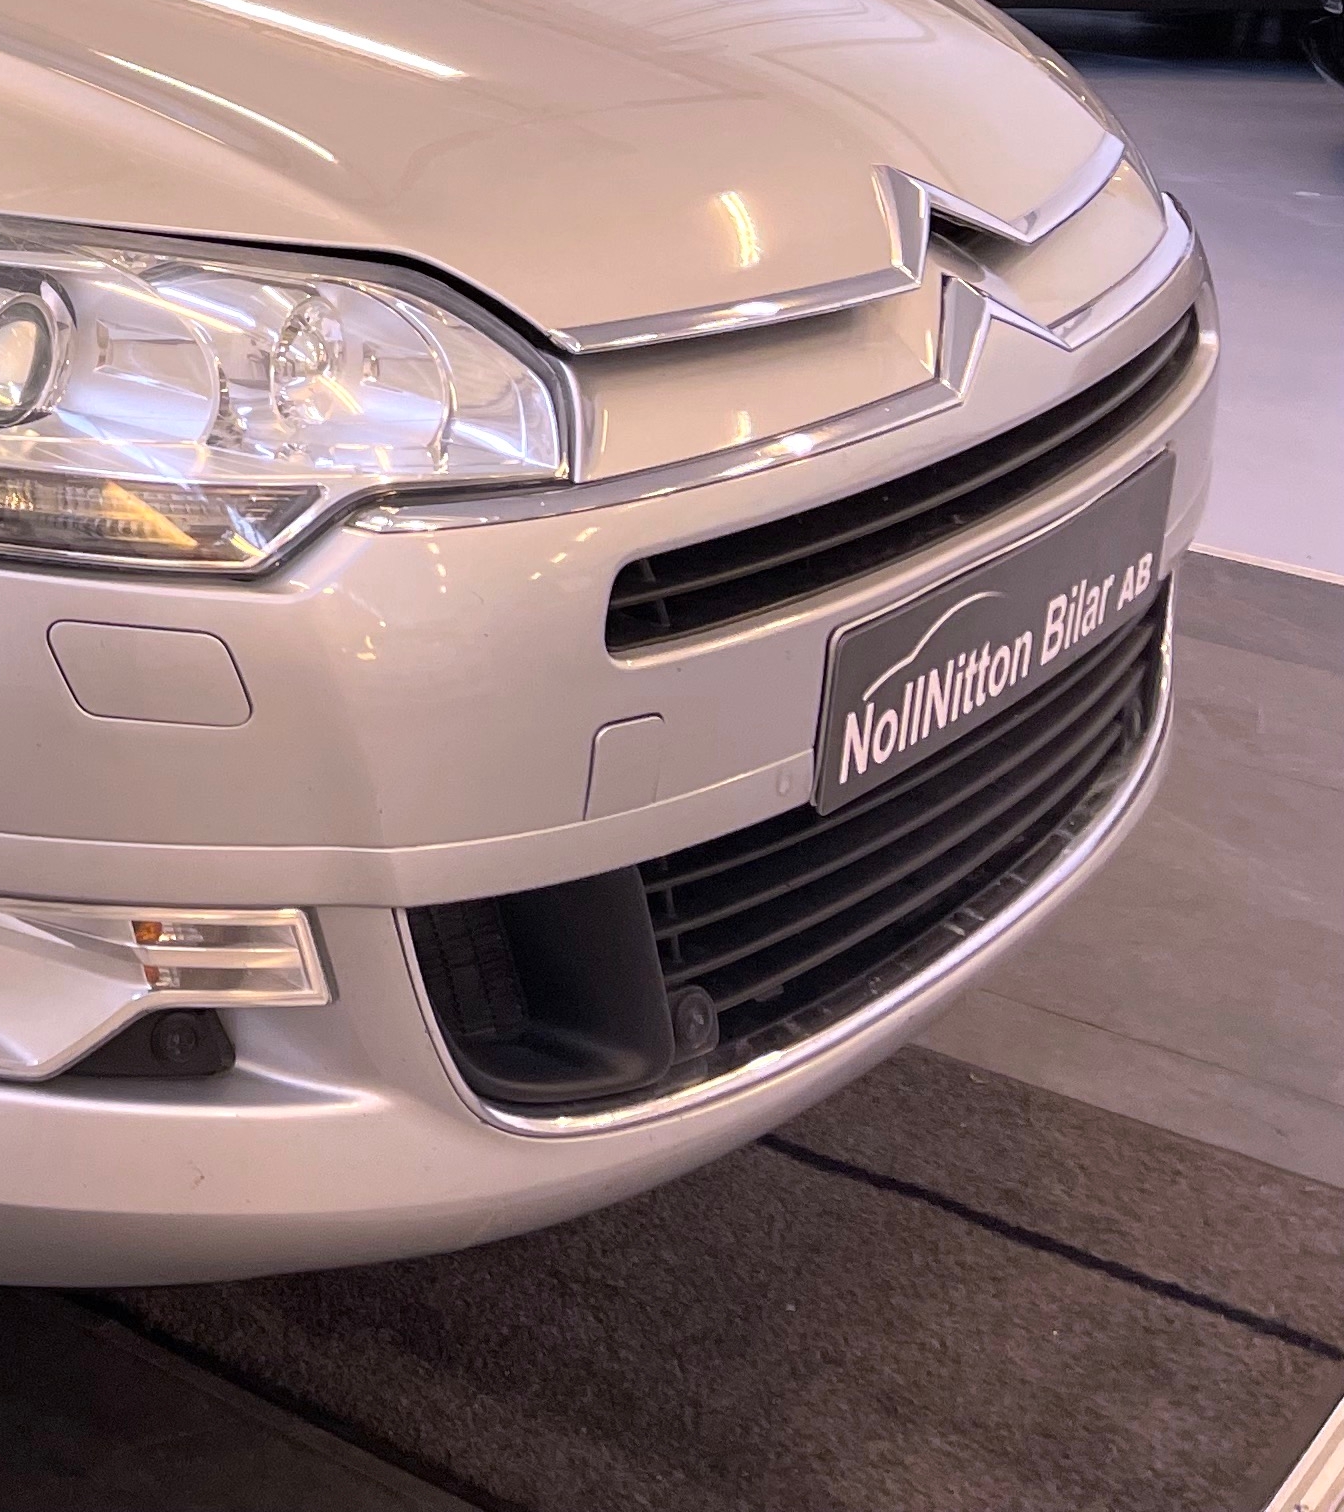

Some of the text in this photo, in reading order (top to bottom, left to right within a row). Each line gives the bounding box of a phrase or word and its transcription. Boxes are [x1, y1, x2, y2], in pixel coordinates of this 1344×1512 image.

[838, 551, 1154, 785] NollNitton Bilar AB
